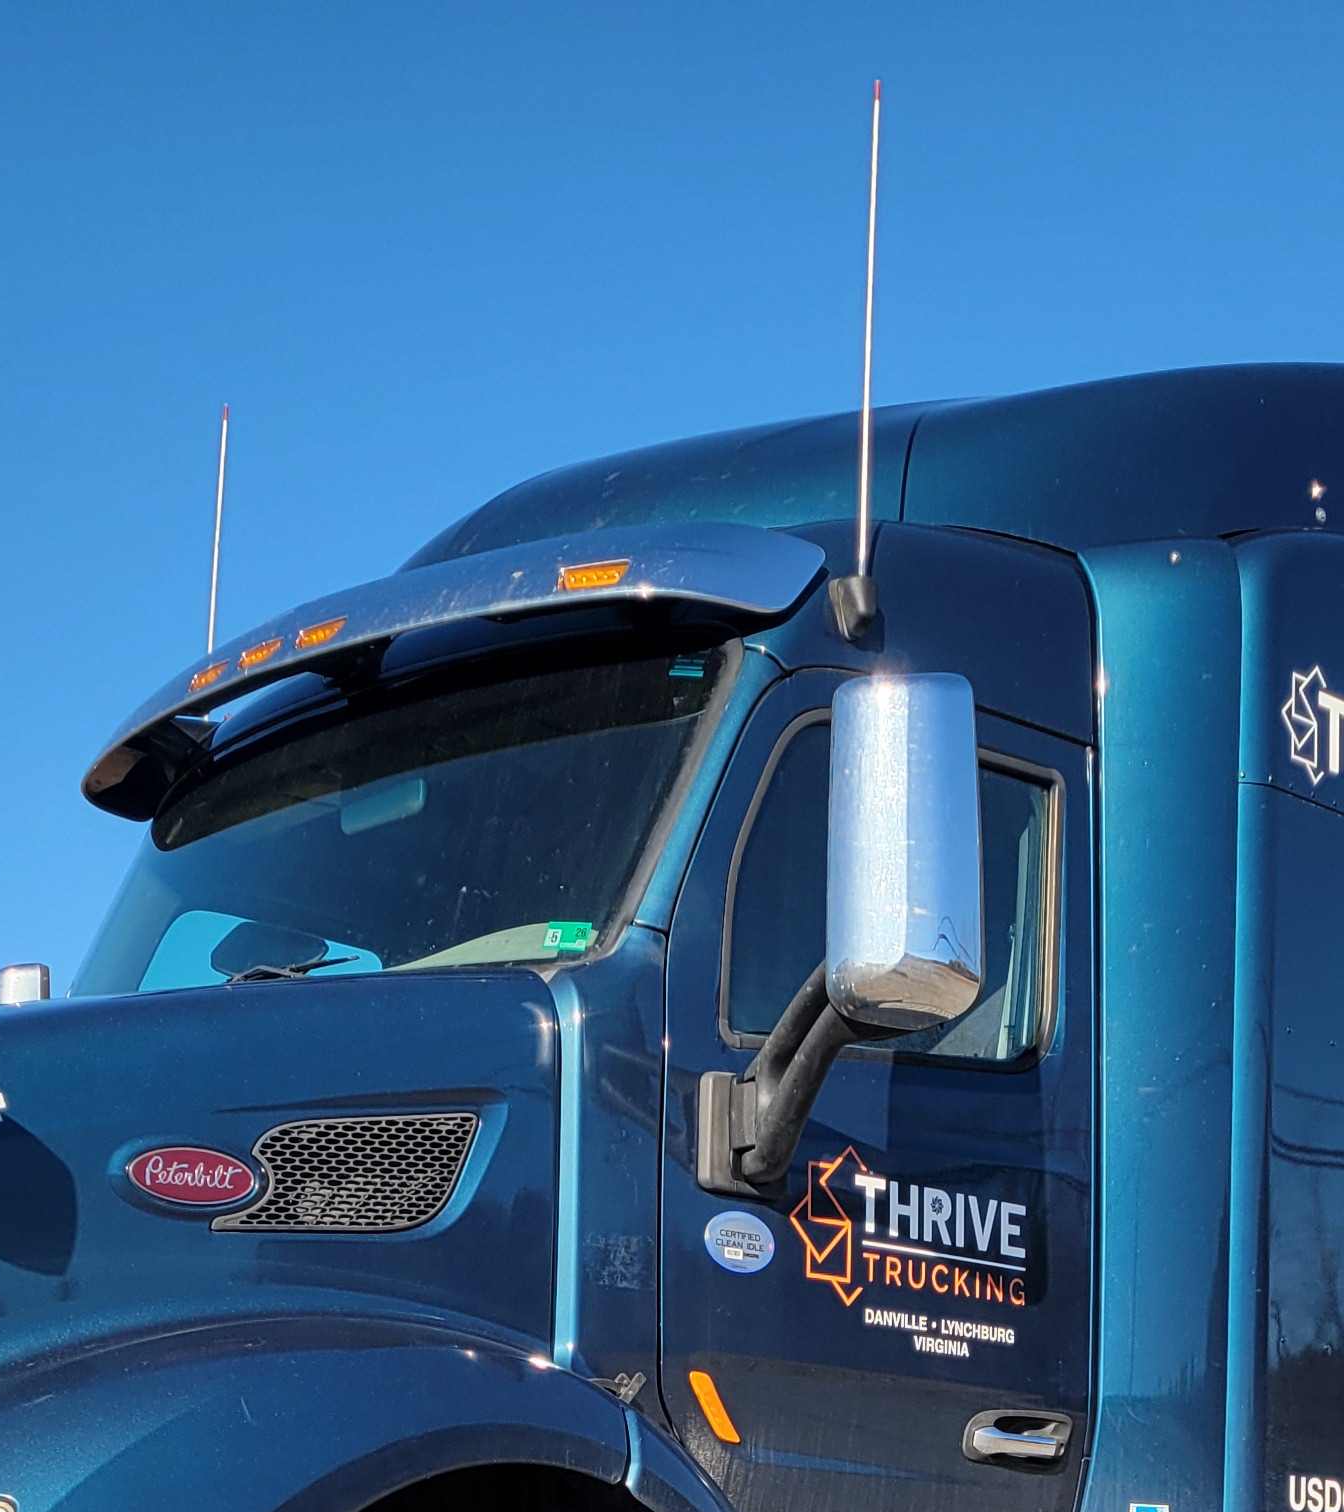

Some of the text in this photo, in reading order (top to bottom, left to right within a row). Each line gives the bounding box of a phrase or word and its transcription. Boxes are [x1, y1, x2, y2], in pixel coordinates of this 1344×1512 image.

[144, 1158, 242, 1192] Peterbilt
[855, 1174, 1026, 1258] THRIVE
[716, 1239, 743, 1249] CLEAN
[719, 1229, 761, 1242] CERTIFIED
[862, 1253, 1026, 1305] TRUCKING
[864, 1309, 1015, 1343] DANVILLE LYNCHBURG
[913, 1335, 970, 1357] VIRGINIA
